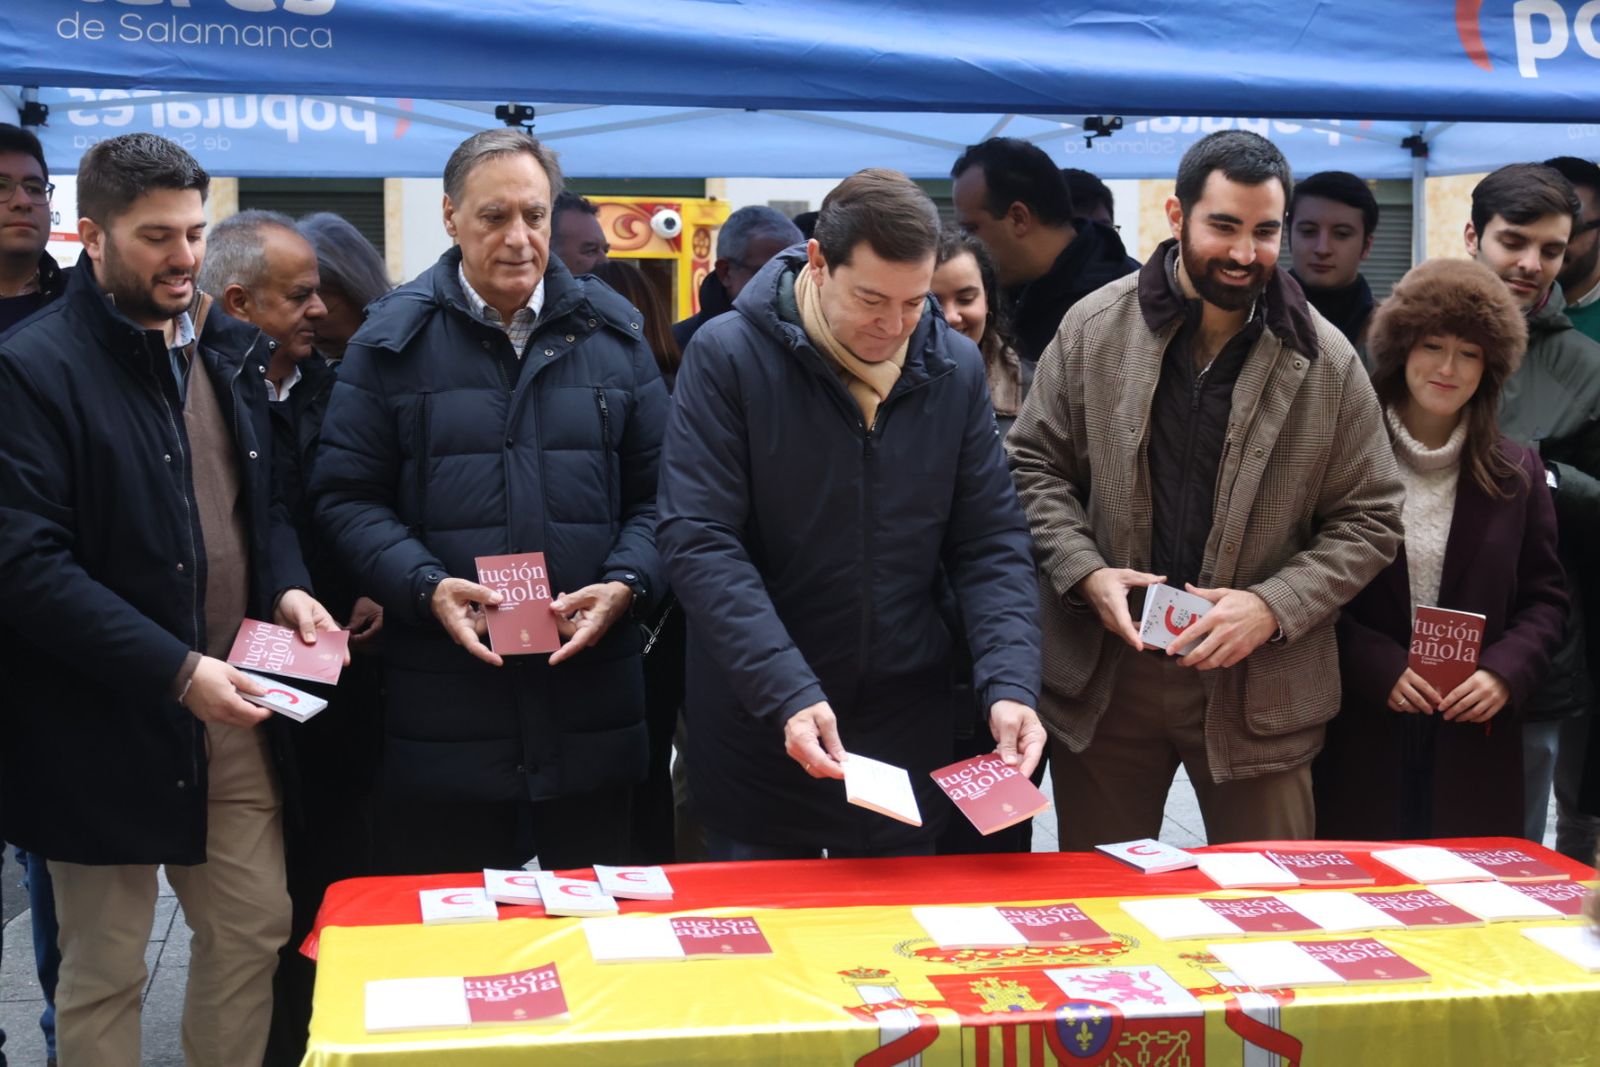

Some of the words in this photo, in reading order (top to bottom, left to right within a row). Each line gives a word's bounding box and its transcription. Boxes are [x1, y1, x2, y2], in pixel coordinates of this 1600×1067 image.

[56, 10, 105, 40] de
[118, 12, 334, 48] Salamanca
[479, 562, 545, 584] tución
[494, 580, 550, 603] ñola
[242, 623, 273, 666] tución
[1414, 618, 1480, 643] tución
[262, 628, 295, 672] añola
[1410, 636, 1476, 663] añola
[936, 759, 1006, 788] tución
[949, 766, 1019, 801] añola
